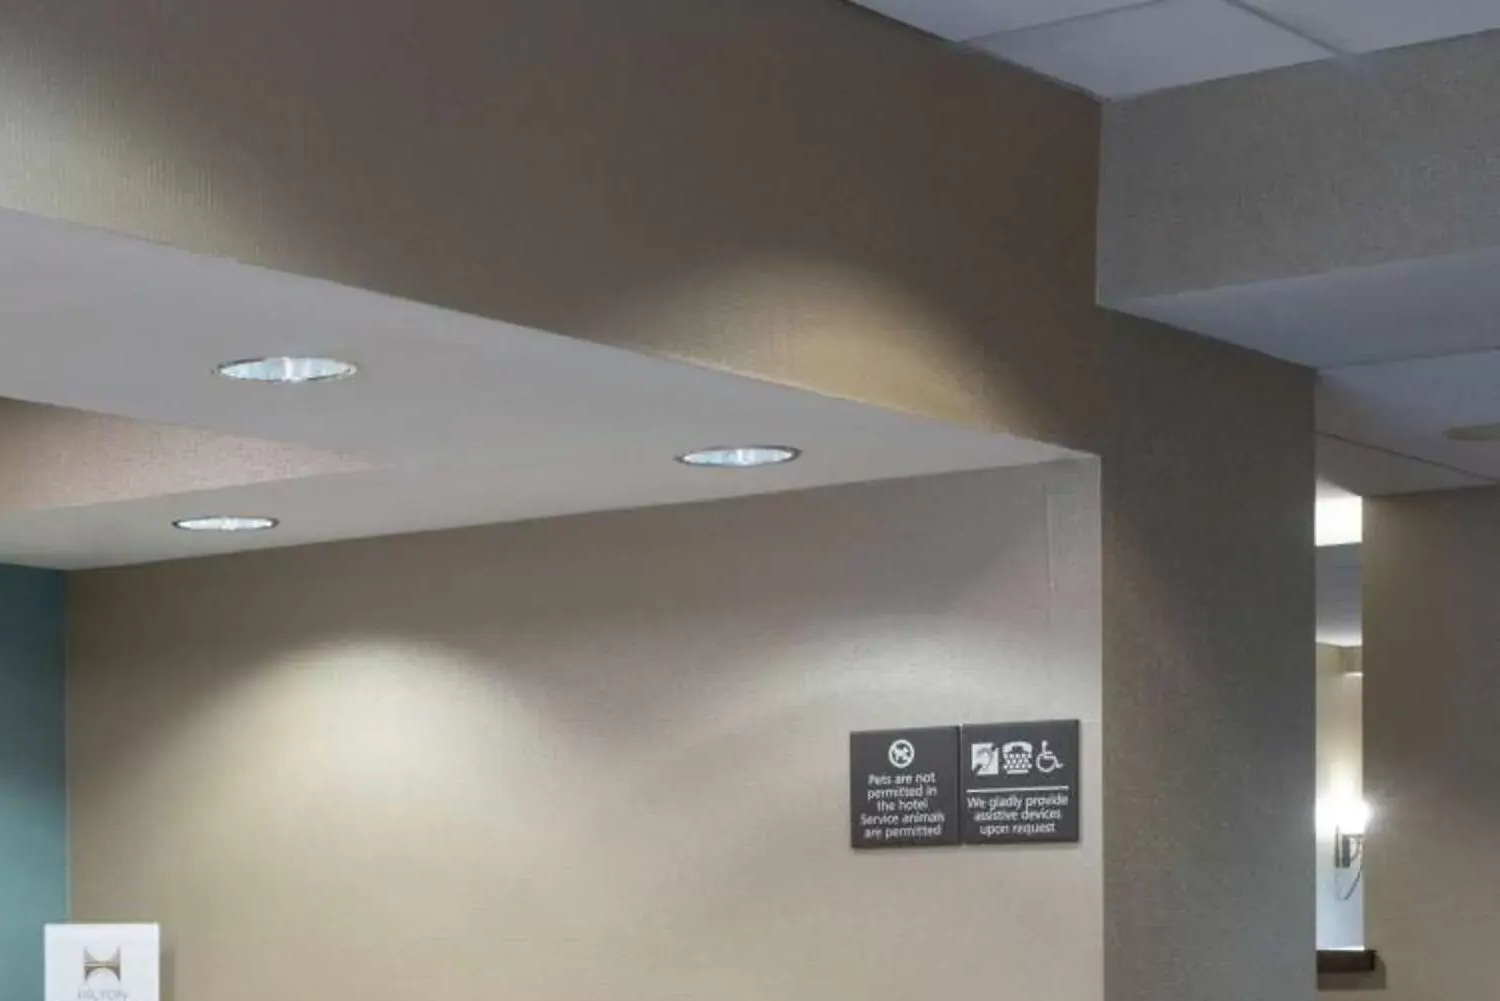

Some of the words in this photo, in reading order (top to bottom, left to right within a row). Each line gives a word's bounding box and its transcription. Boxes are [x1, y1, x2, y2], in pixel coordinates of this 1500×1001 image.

[868, 773, 891, 785] Pets
[895, 775, 912, 785] are
[915, 772, 936, 784] not
[867, 785, 923, 800] permitted
[926, 786, 937, 797] in
[876, 799, 896, 812] the
[967, 796, 986, 809] We
[989, 794, 1022, 812] gladly
[1025, 793, 1069, 810] provide
[860, 812, 899, 826] Service
[864, 828, 882, 839] are
[885, 824, 942, 840] permitted
[979, 824, 1010, 838] upon
